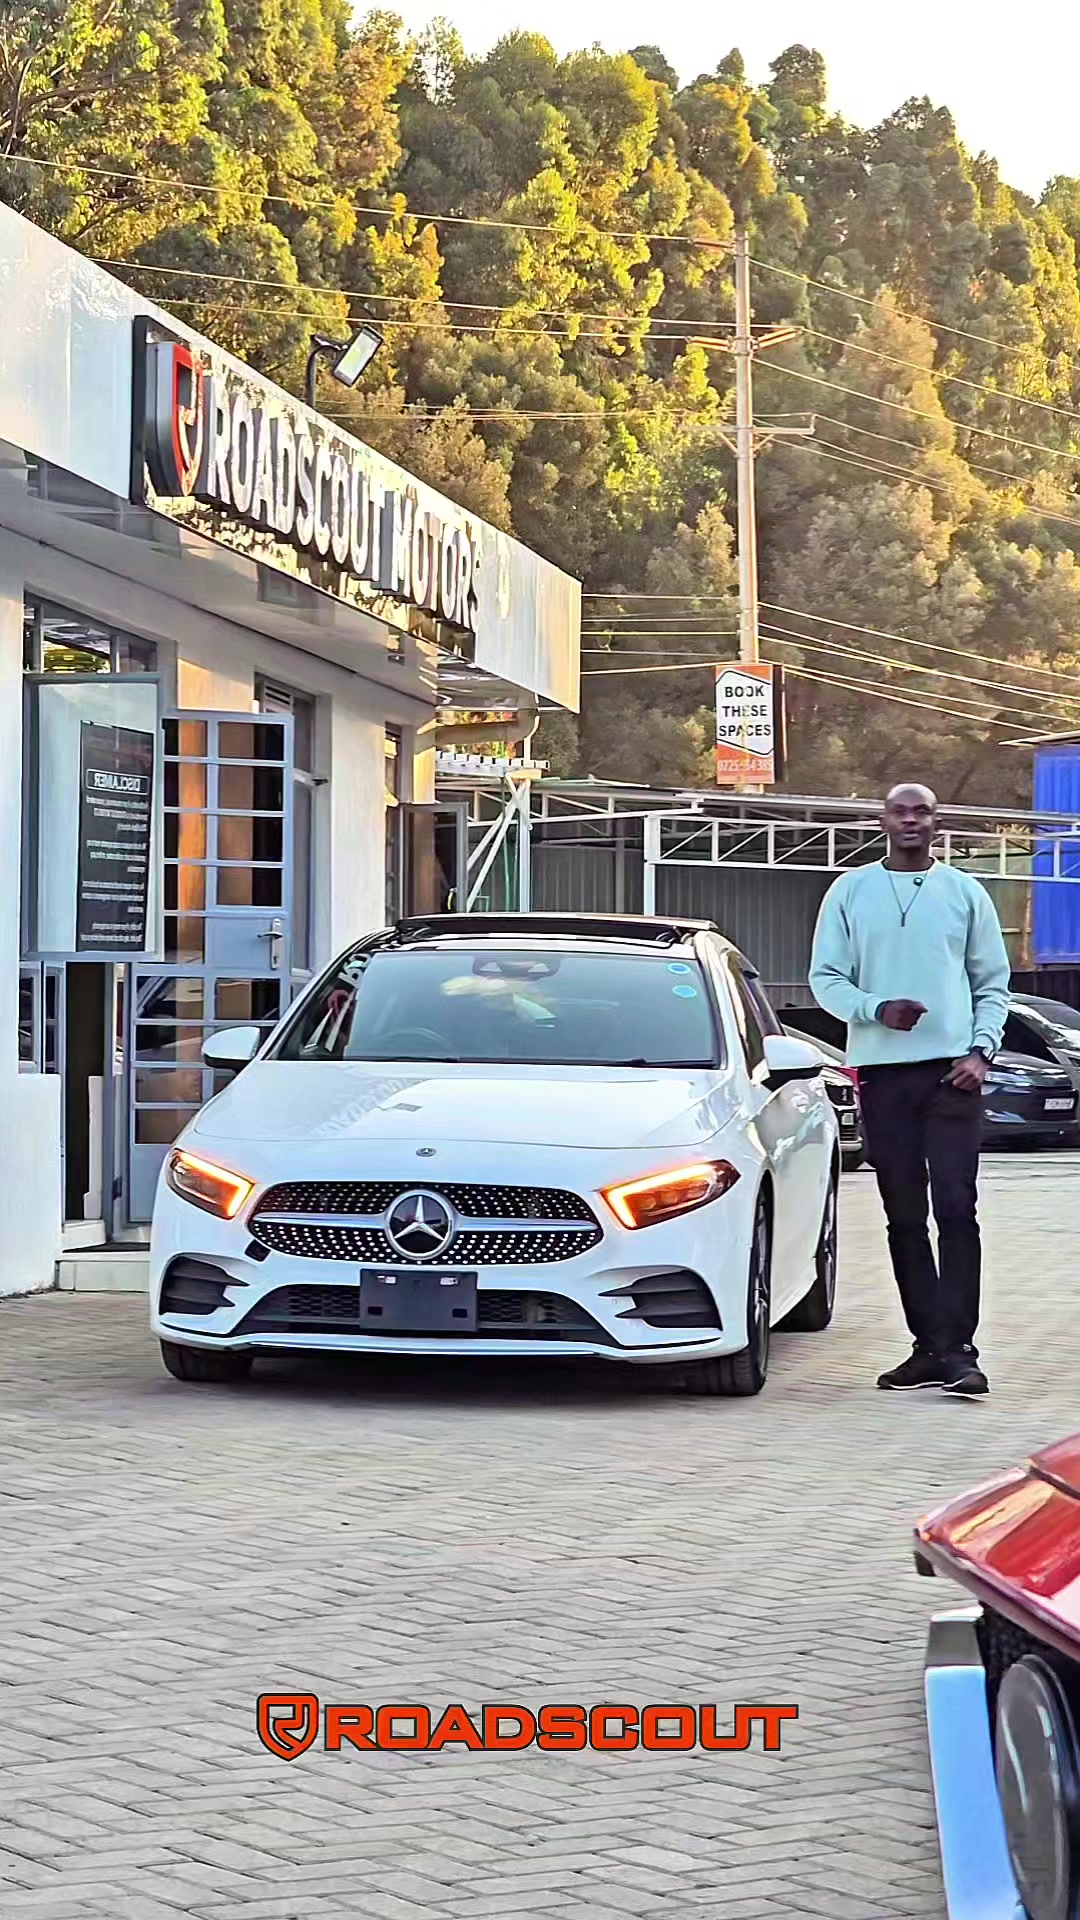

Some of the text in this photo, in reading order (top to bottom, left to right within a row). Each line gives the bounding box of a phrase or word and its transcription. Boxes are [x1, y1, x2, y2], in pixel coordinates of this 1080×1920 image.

[207, 370, 480, 634] ROADSCOUT MOTORS
[724, 685, 765, 698] BOOK
[722, 705, 768, 717] THESE
[719, 724, 771, 737] SPACES
